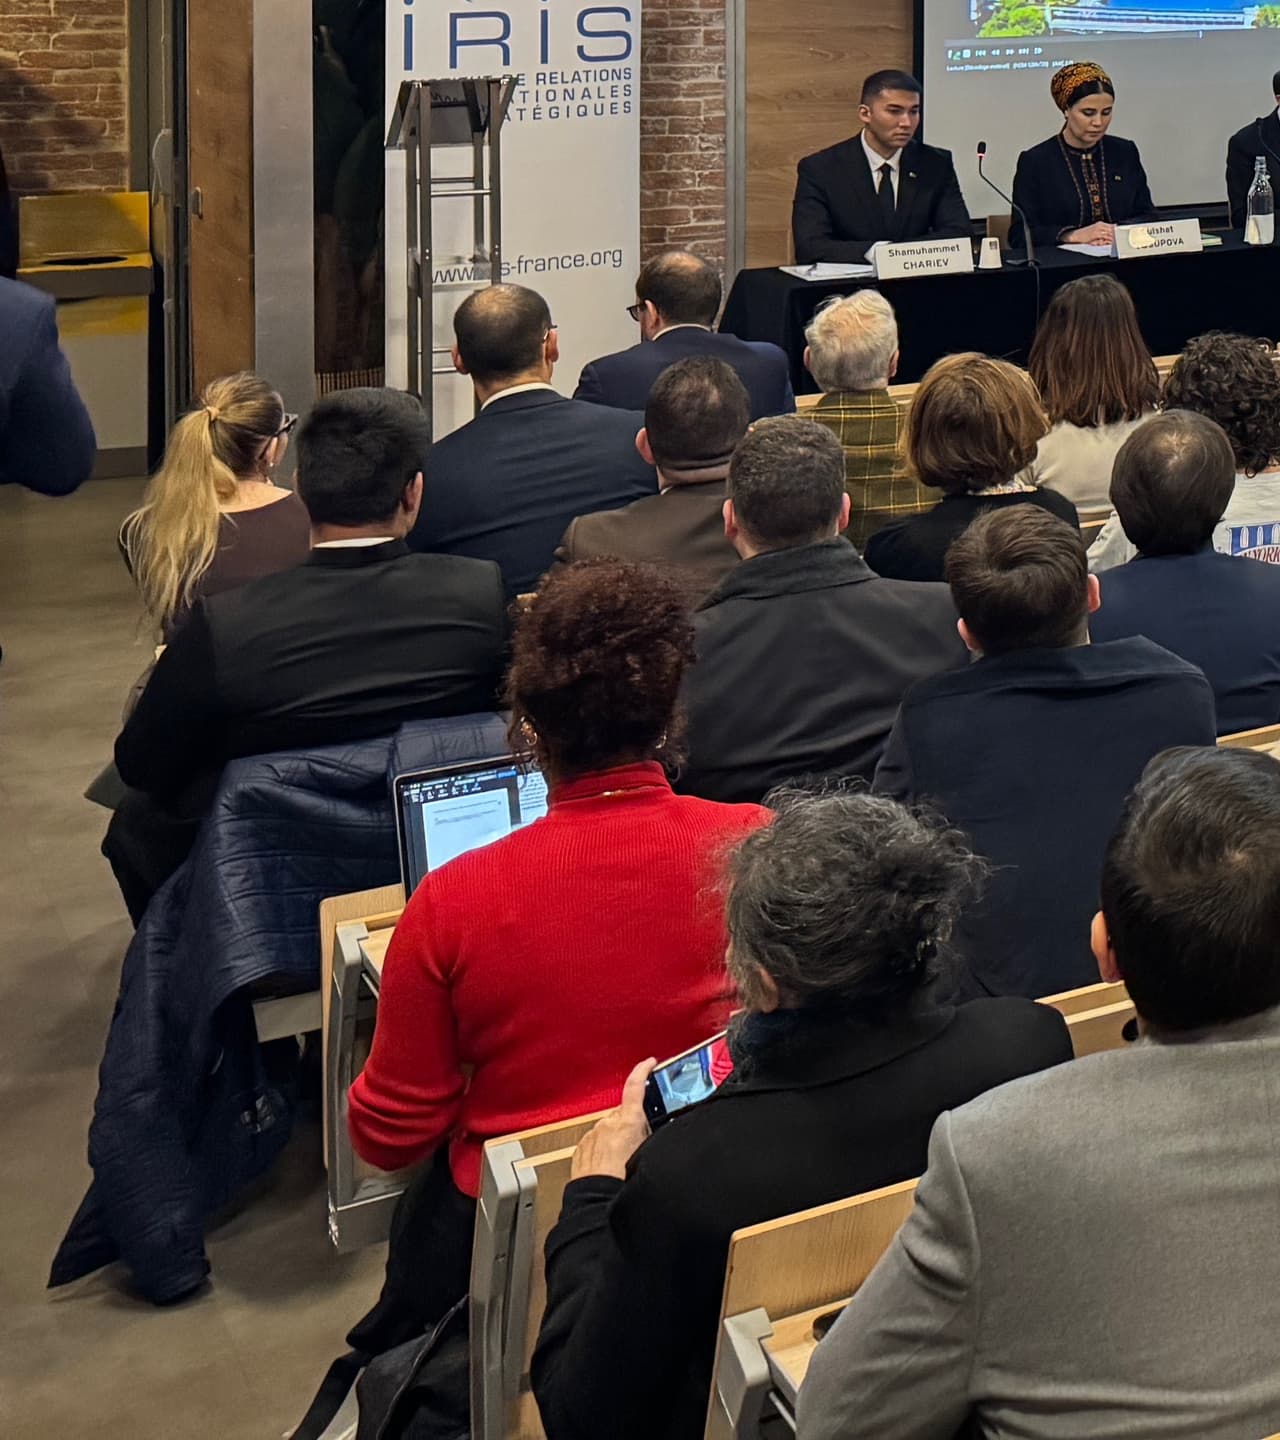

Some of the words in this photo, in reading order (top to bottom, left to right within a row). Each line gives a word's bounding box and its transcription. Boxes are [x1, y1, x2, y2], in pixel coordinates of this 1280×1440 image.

[536, 67, 632, 86] RELATIONS
[1146, 225, 1174, 235] ulshat
[888, 243, 961, 258] Shamuhammet
[903, 258, 950, 270] CHARIEV
